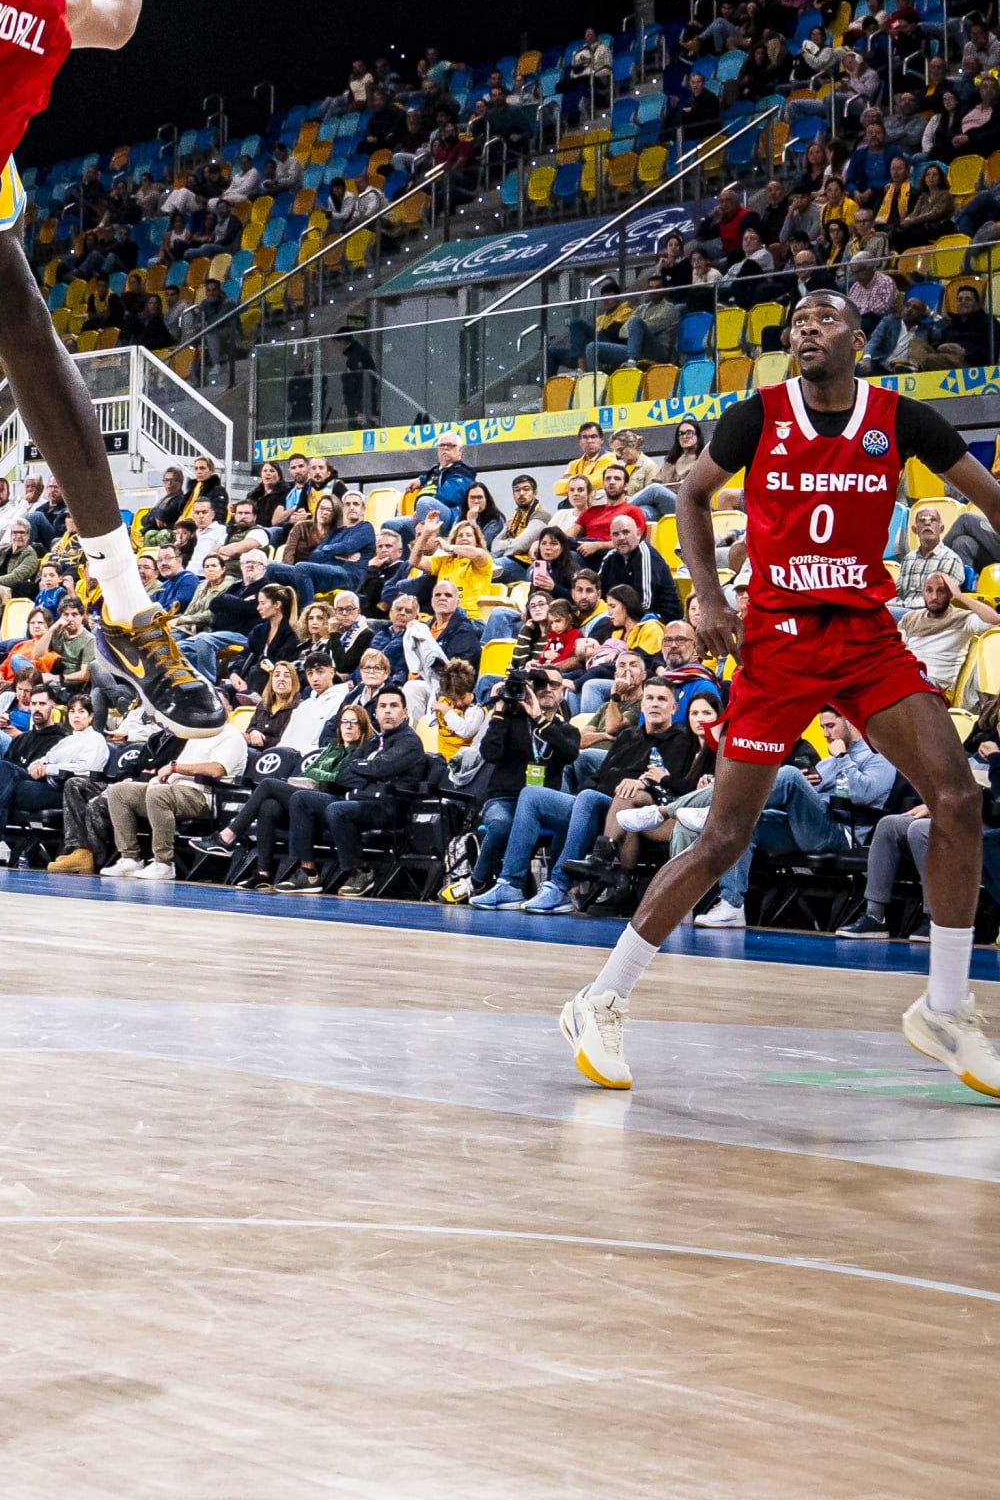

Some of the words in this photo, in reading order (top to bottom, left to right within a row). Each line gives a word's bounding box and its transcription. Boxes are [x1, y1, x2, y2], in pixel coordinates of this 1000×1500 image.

[766, 471, 794, 491] SL
[800, 473, 888, 493] BENFICA
[809, 503, 835, 544] 0
[789, 554, 858, 567] conservas
